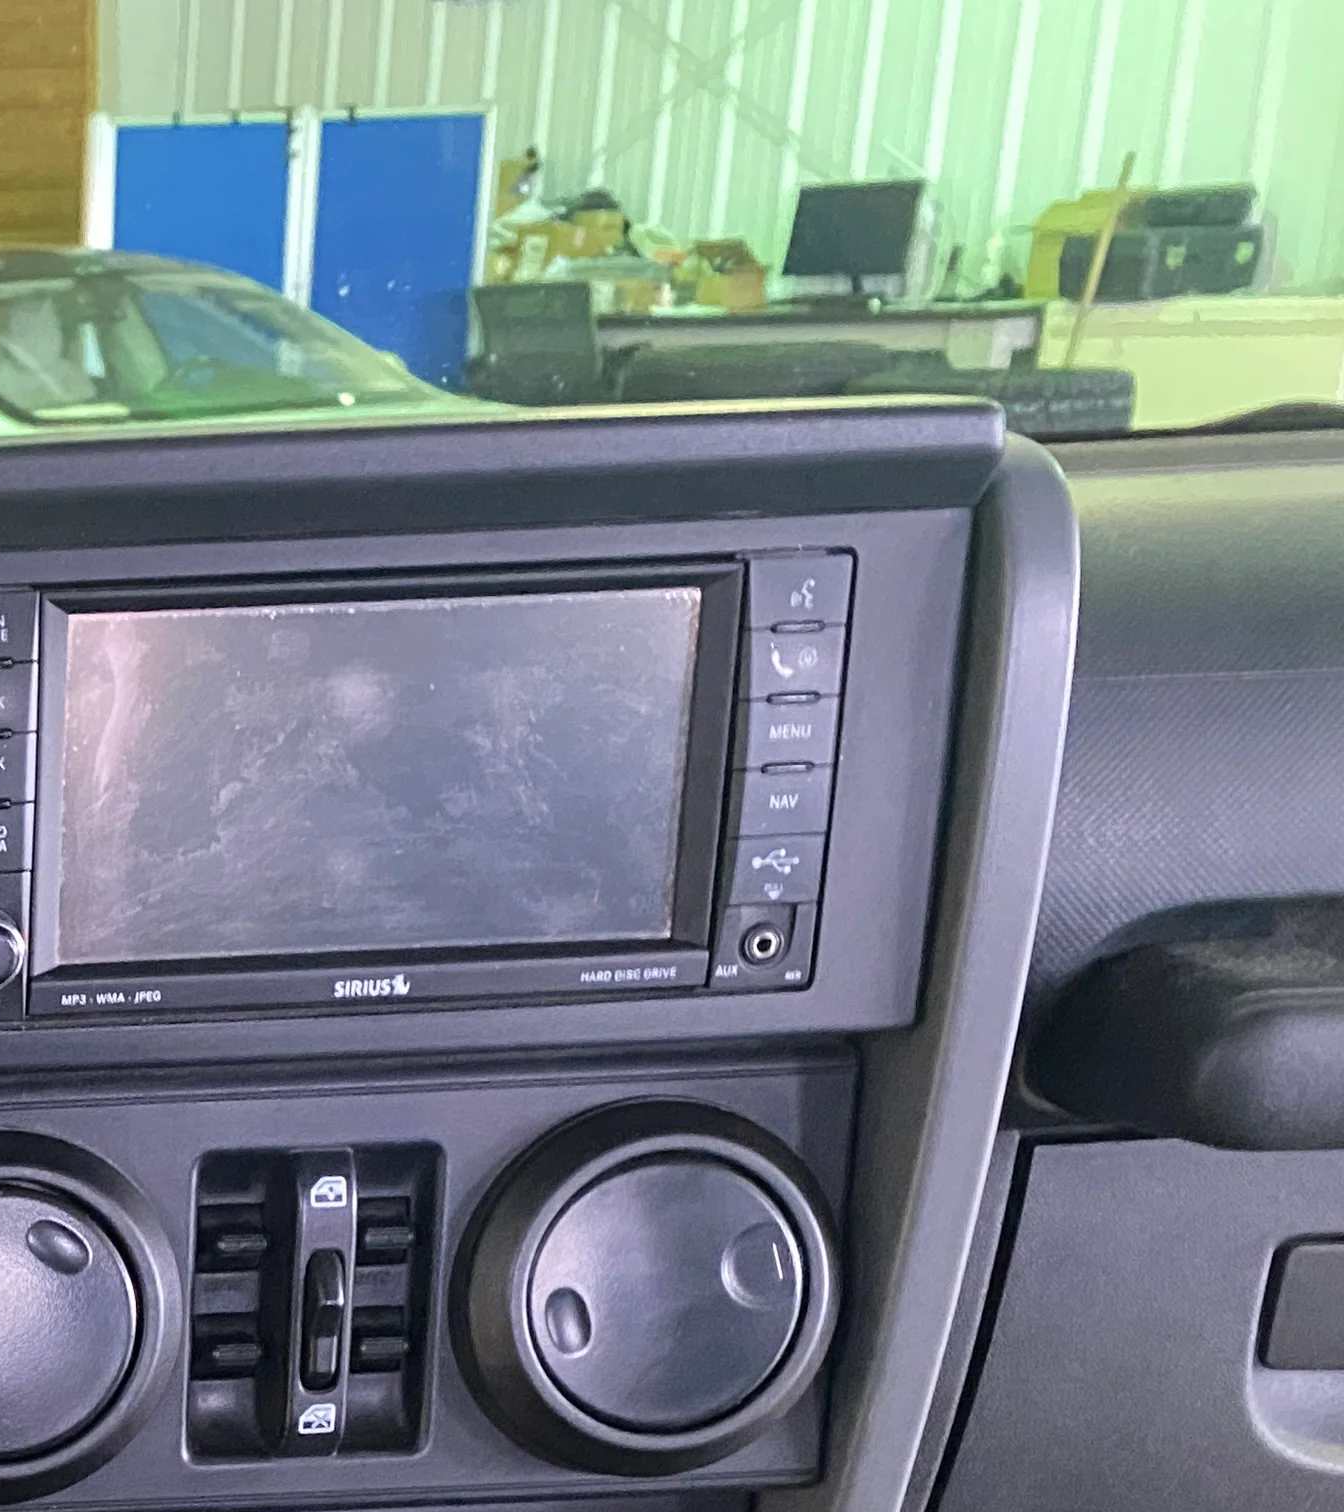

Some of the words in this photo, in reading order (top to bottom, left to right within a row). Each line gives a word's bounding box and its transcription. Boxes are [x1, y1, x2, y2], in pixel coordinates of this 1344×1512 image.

[769, 724, 812, 739] MENU
[769, 794, 798, 809] NAV
[580, 969, 612, 983] HARD
[643, 965, 677, 981] DRIVE
[715, 964, 739, 977] AUX
[333, 978, 392, 998] SIRIUS
[61, 993, 87, 1006] MP3
